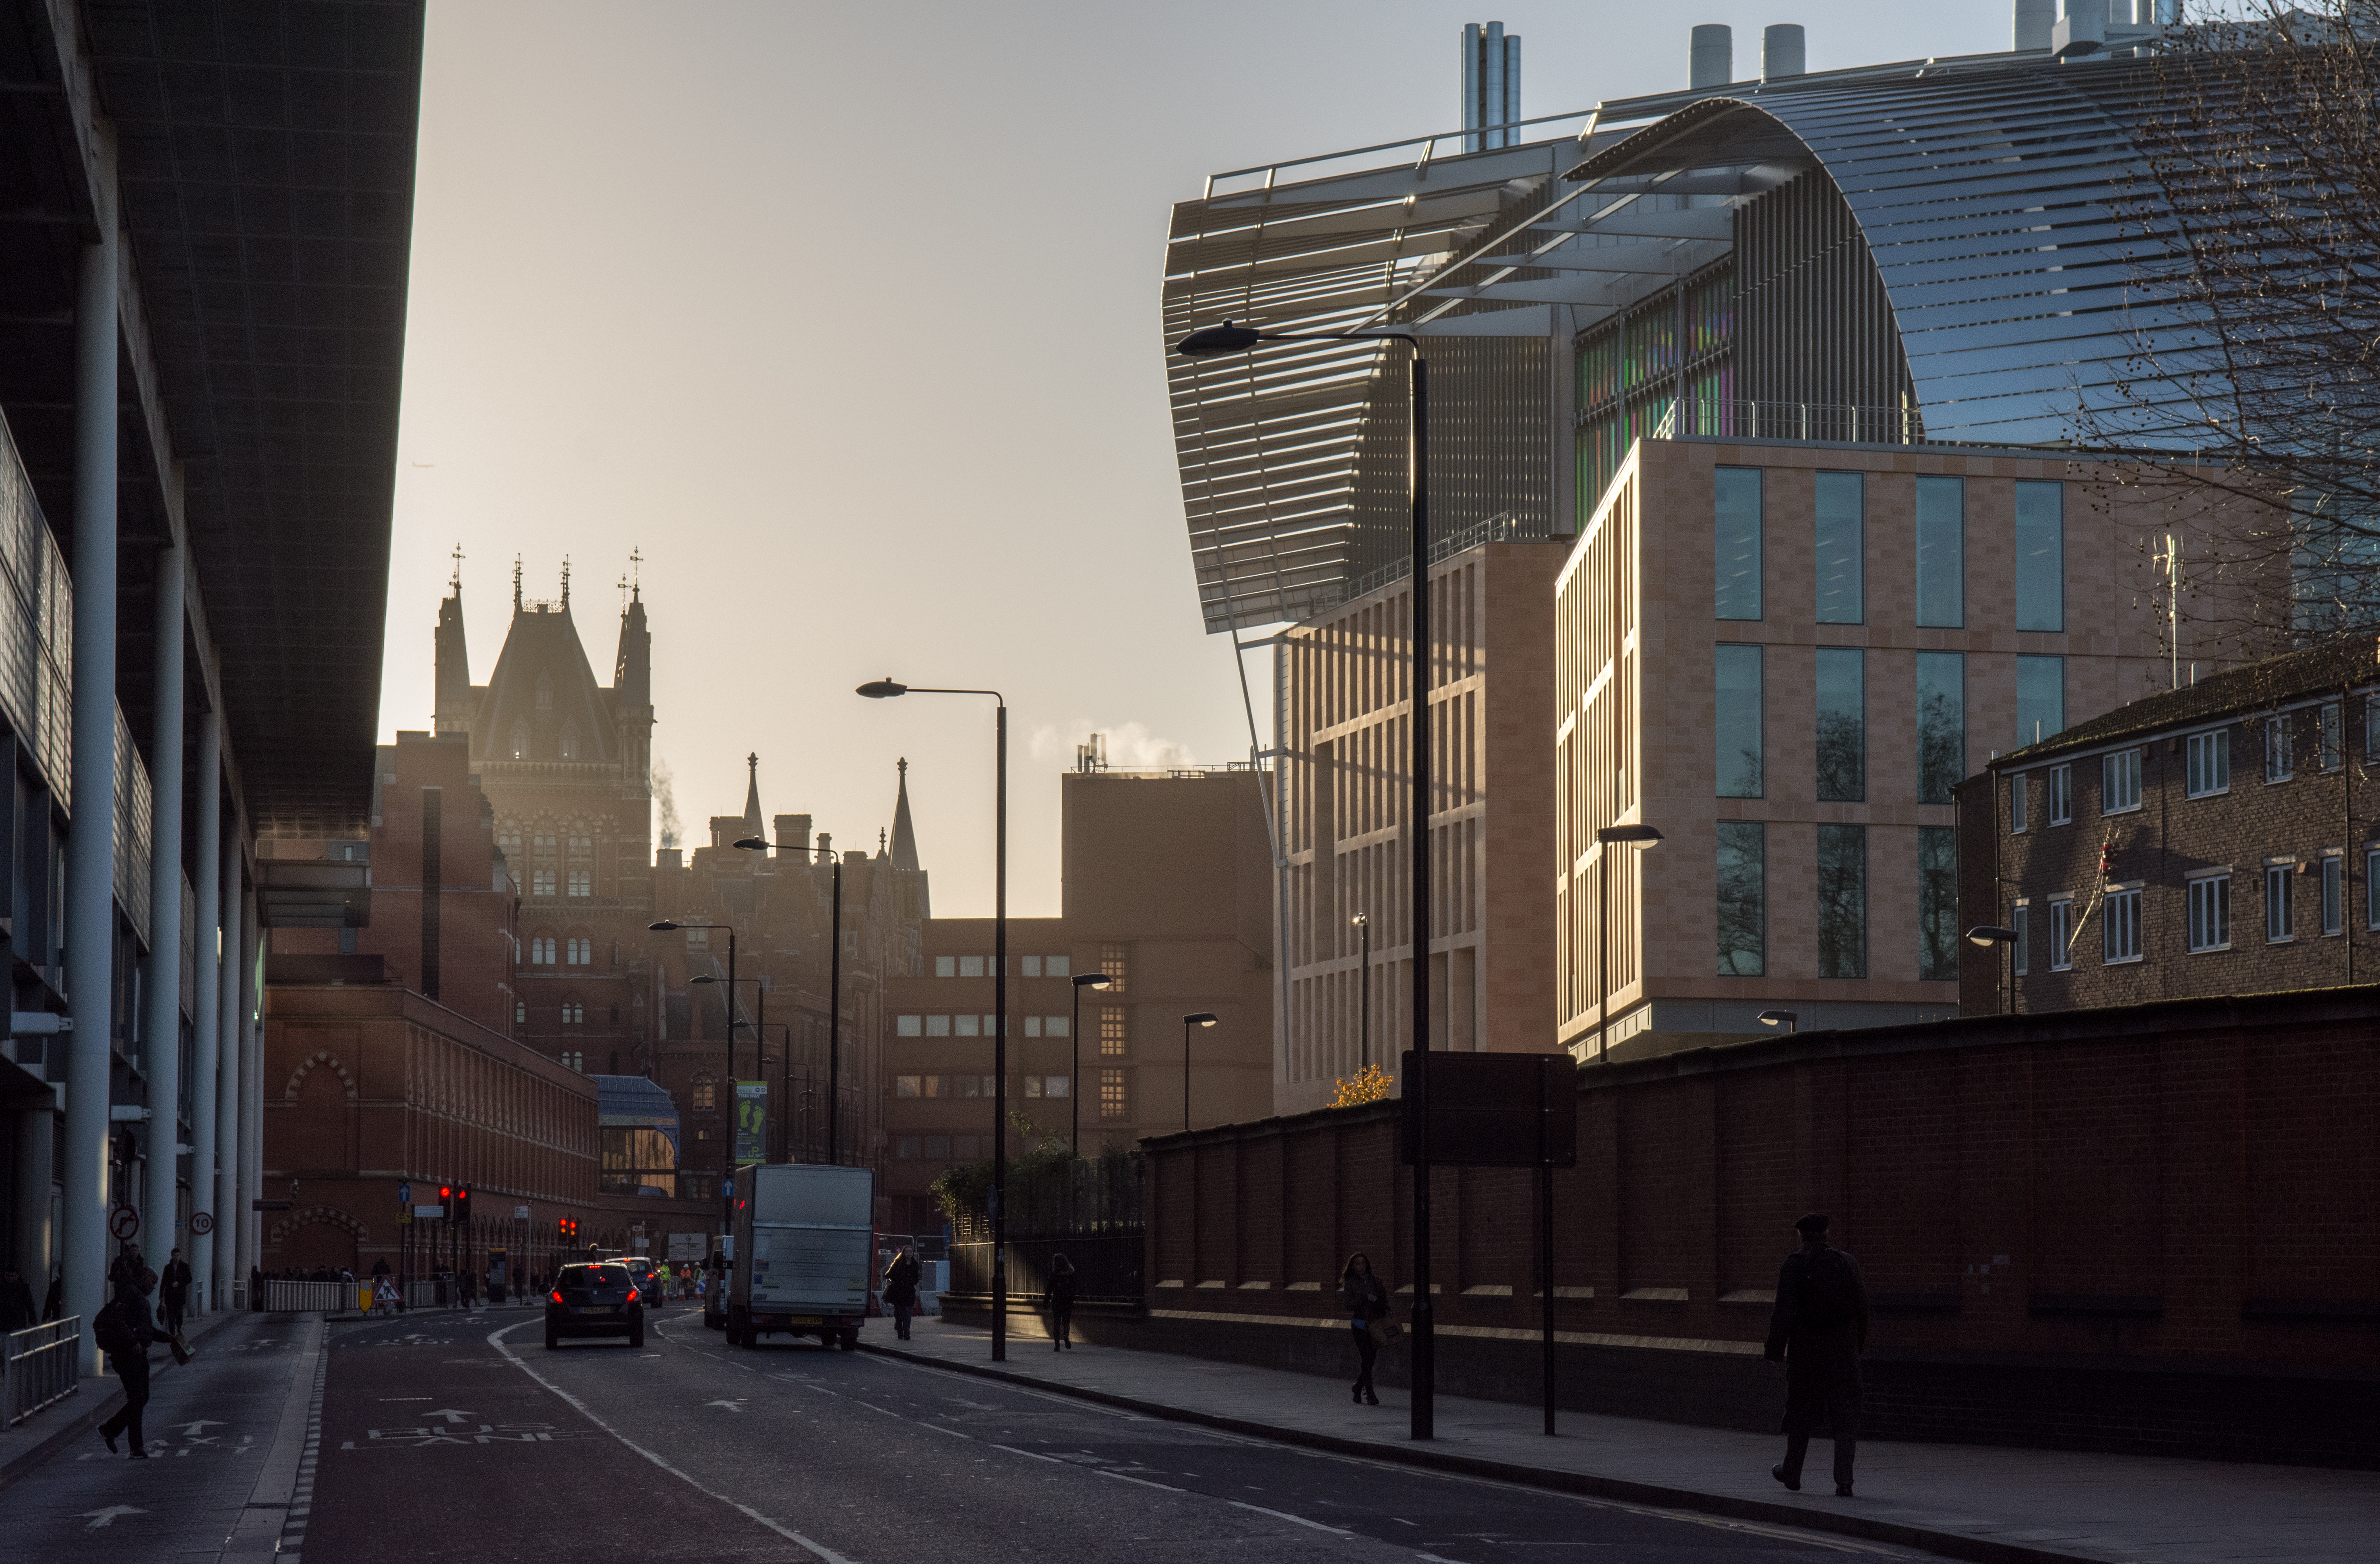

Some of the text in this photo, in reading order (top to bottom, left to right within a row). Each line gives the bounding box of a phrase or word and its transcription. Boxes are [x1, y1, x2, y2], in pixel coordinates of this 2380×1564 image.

[196, 1219, 209, 1227] 10
[368, 1423, 555, 1439] BUS
[341, 1431, 599, 1449] LANE
